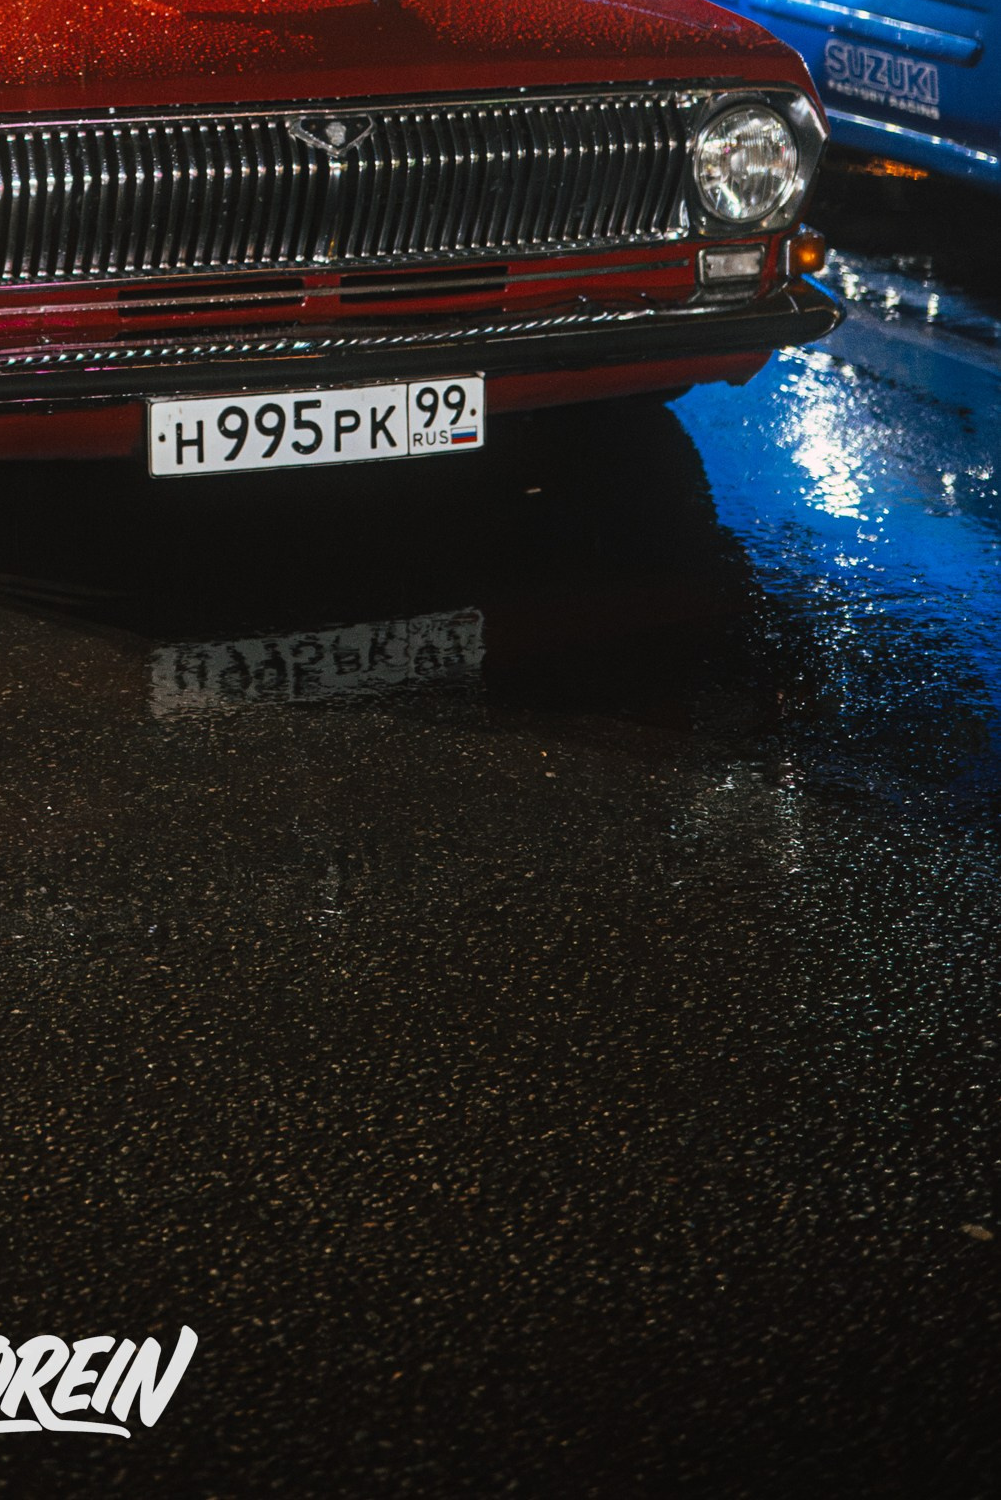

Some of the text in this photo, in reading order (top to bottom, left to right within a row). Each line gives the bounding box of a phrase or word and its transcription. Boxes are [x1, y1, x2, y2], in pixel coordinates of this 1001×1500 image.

[825, 39, 939, 105] SUZUKI
[415, 383, 467, 429] 99
[412, 429, 449, 447] RUS
